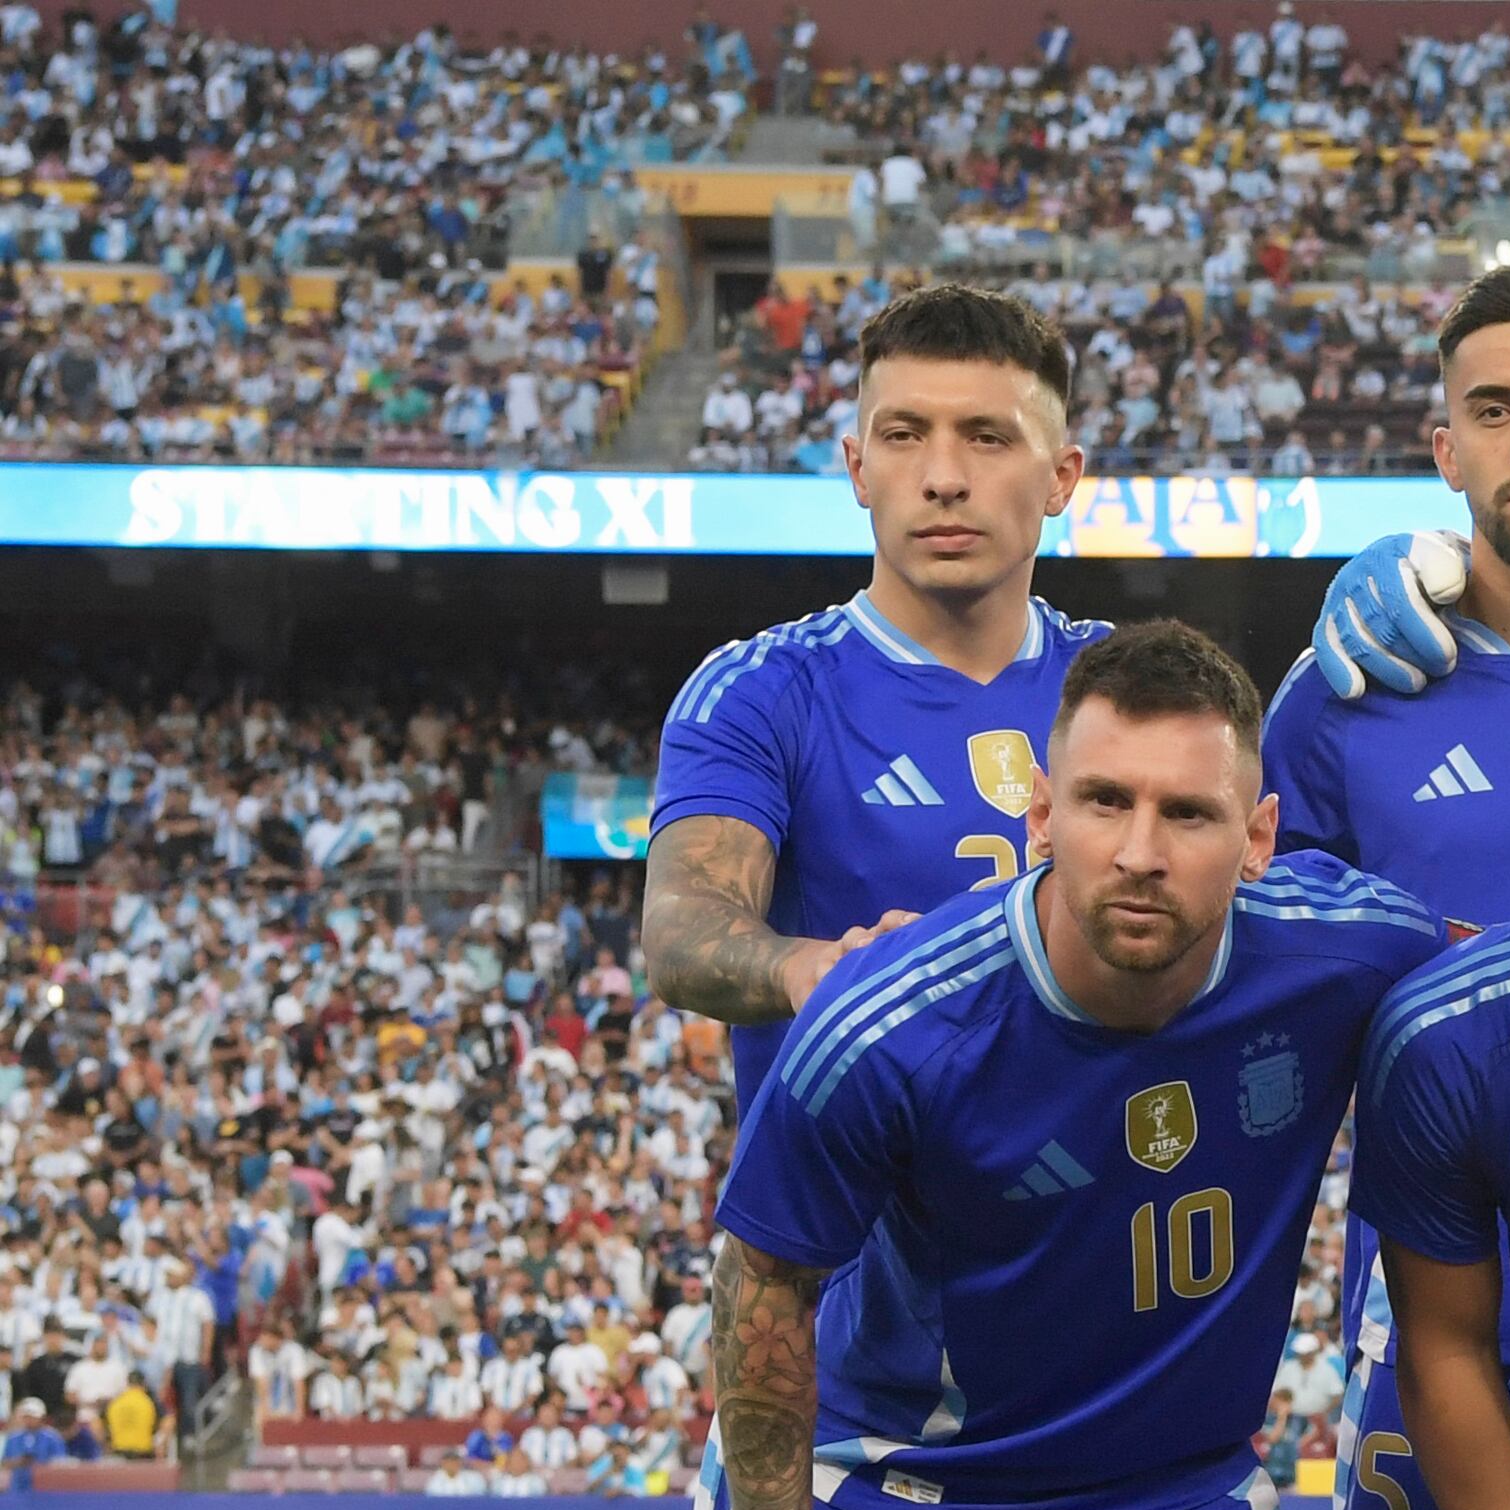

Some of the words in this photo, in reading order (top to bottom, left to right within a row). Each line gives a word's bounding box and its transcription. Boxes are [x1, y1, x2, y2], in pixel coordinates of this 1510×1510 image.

[129, 469, 580, 547] STARTING
[595, 477, 694, 548] XI
[1149, 1136, 1181, 1154] FIFA
[1131, 1187, 1234, 1312] 10
